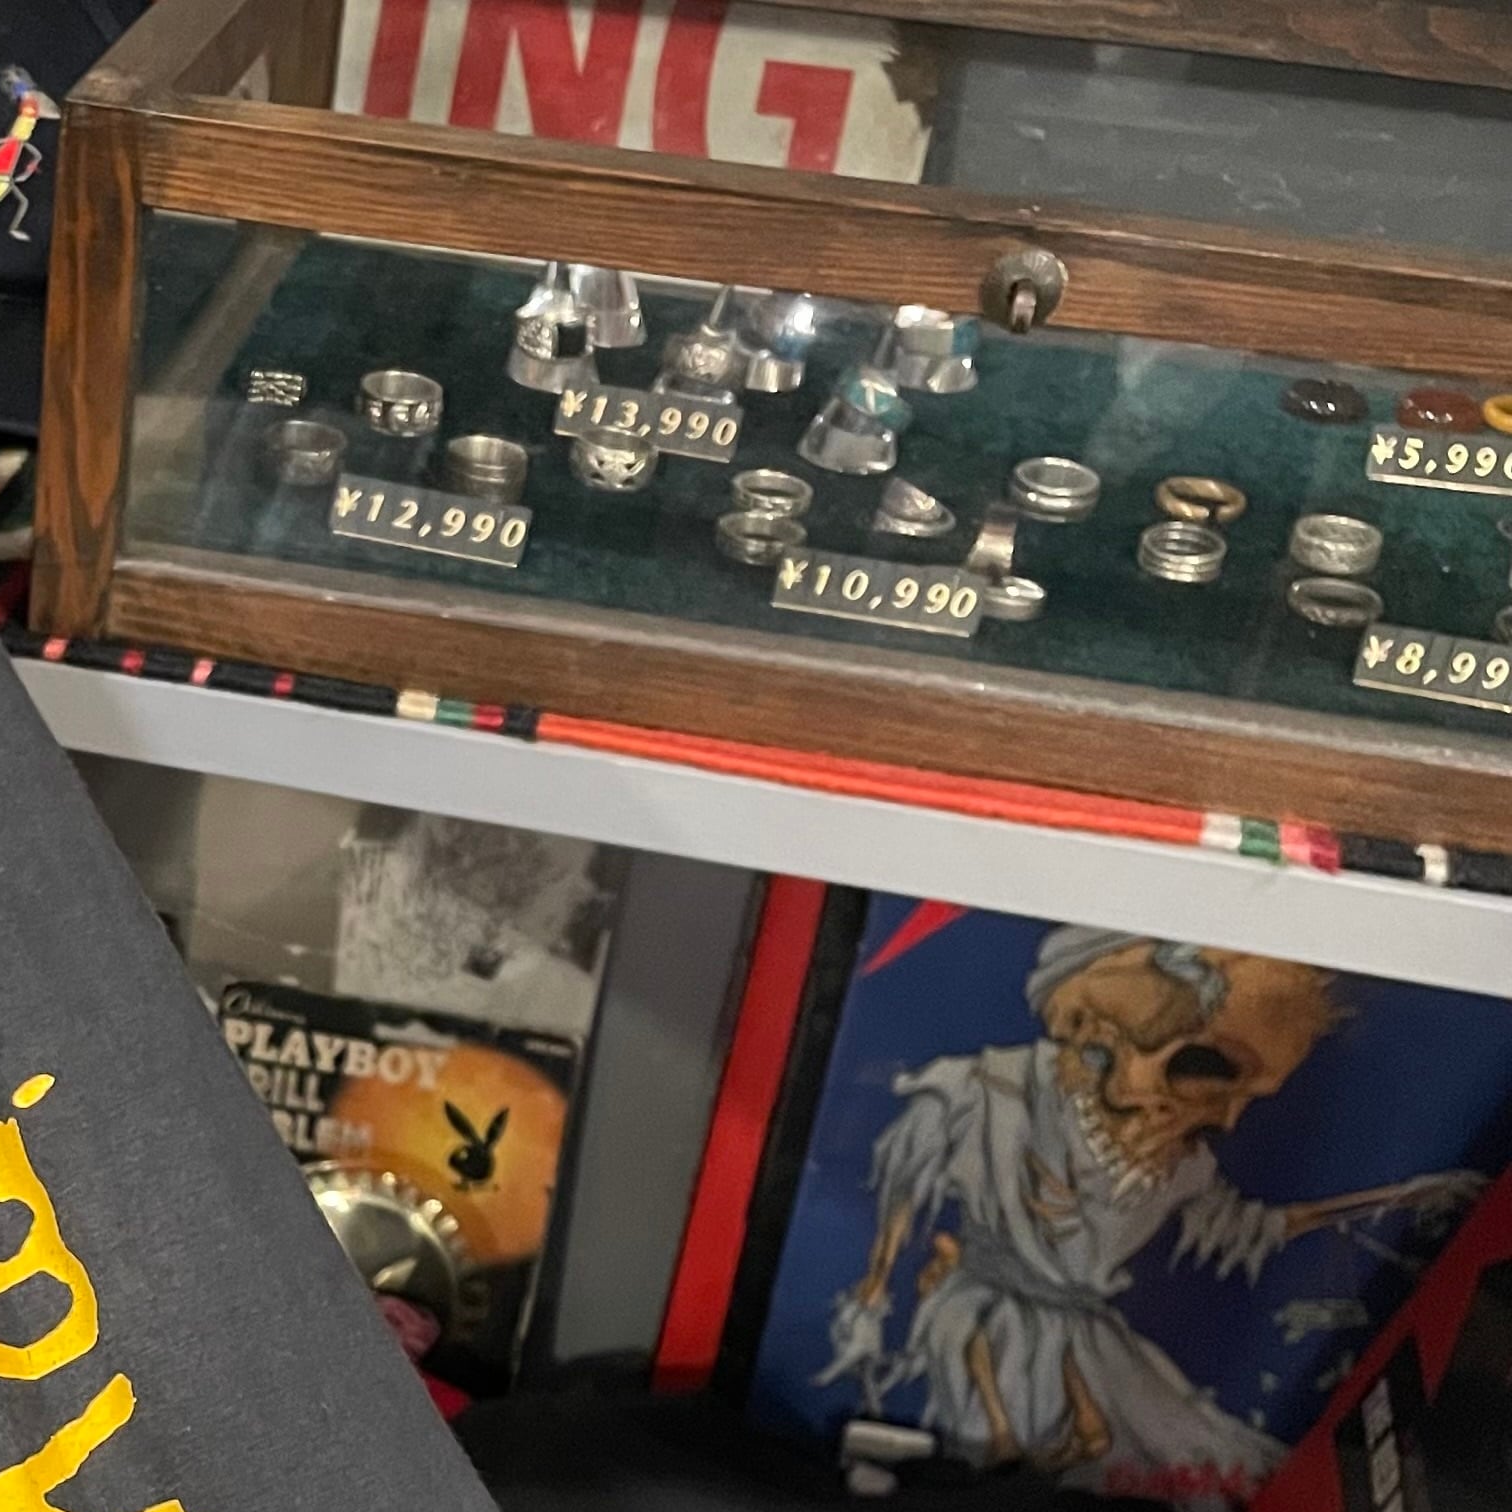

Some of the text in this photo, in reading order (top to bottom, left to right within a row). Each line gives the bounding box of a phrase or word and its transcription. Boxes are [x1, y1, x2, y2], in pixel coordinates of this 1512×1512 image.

[559, 388, 739, 446] ¥13,990
[335, 486, 528, 549] ¥12,990
[779, 557, 978, 618] ¥10,990
[224, 1018, 451, 1089] PLAYBOY
[249, 1063, 326, 1112] RILL
[273, 1110, 373, 1158] BLEM
